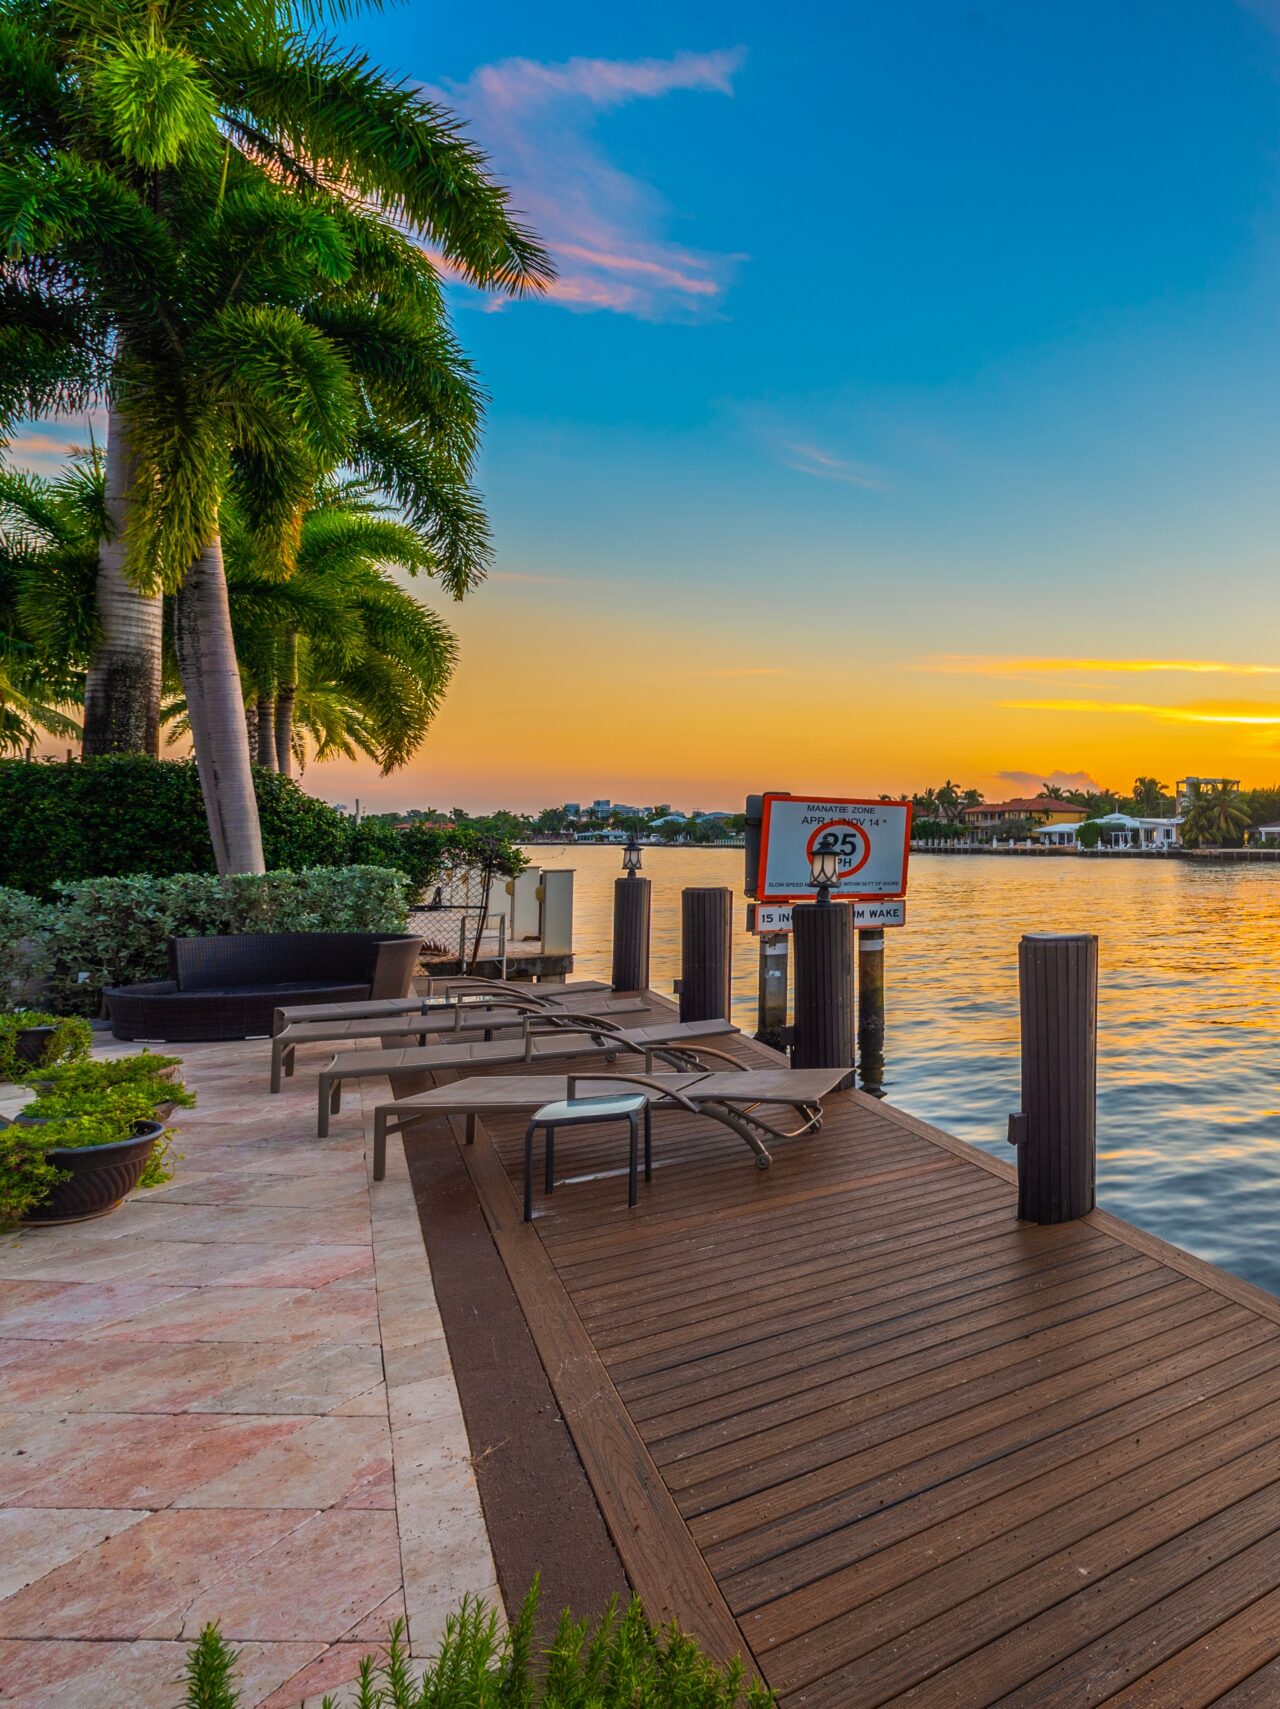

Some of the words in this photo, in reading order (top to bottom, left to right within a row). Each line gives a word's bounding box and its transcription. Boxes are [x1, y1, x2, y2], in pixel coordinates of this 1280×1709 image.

[807, 804, 848, 813] MANATEE
[851, 806, 875, 814] ZONE
[801, 816, 825, 825] APR
[843, 817, 866, 826] NOV
[869, 819, 879, 827] 14
[837, 857, 852, 867] PH
[761, 913, 774, 923] 15
[869, 908, 900, 919] WAKE
